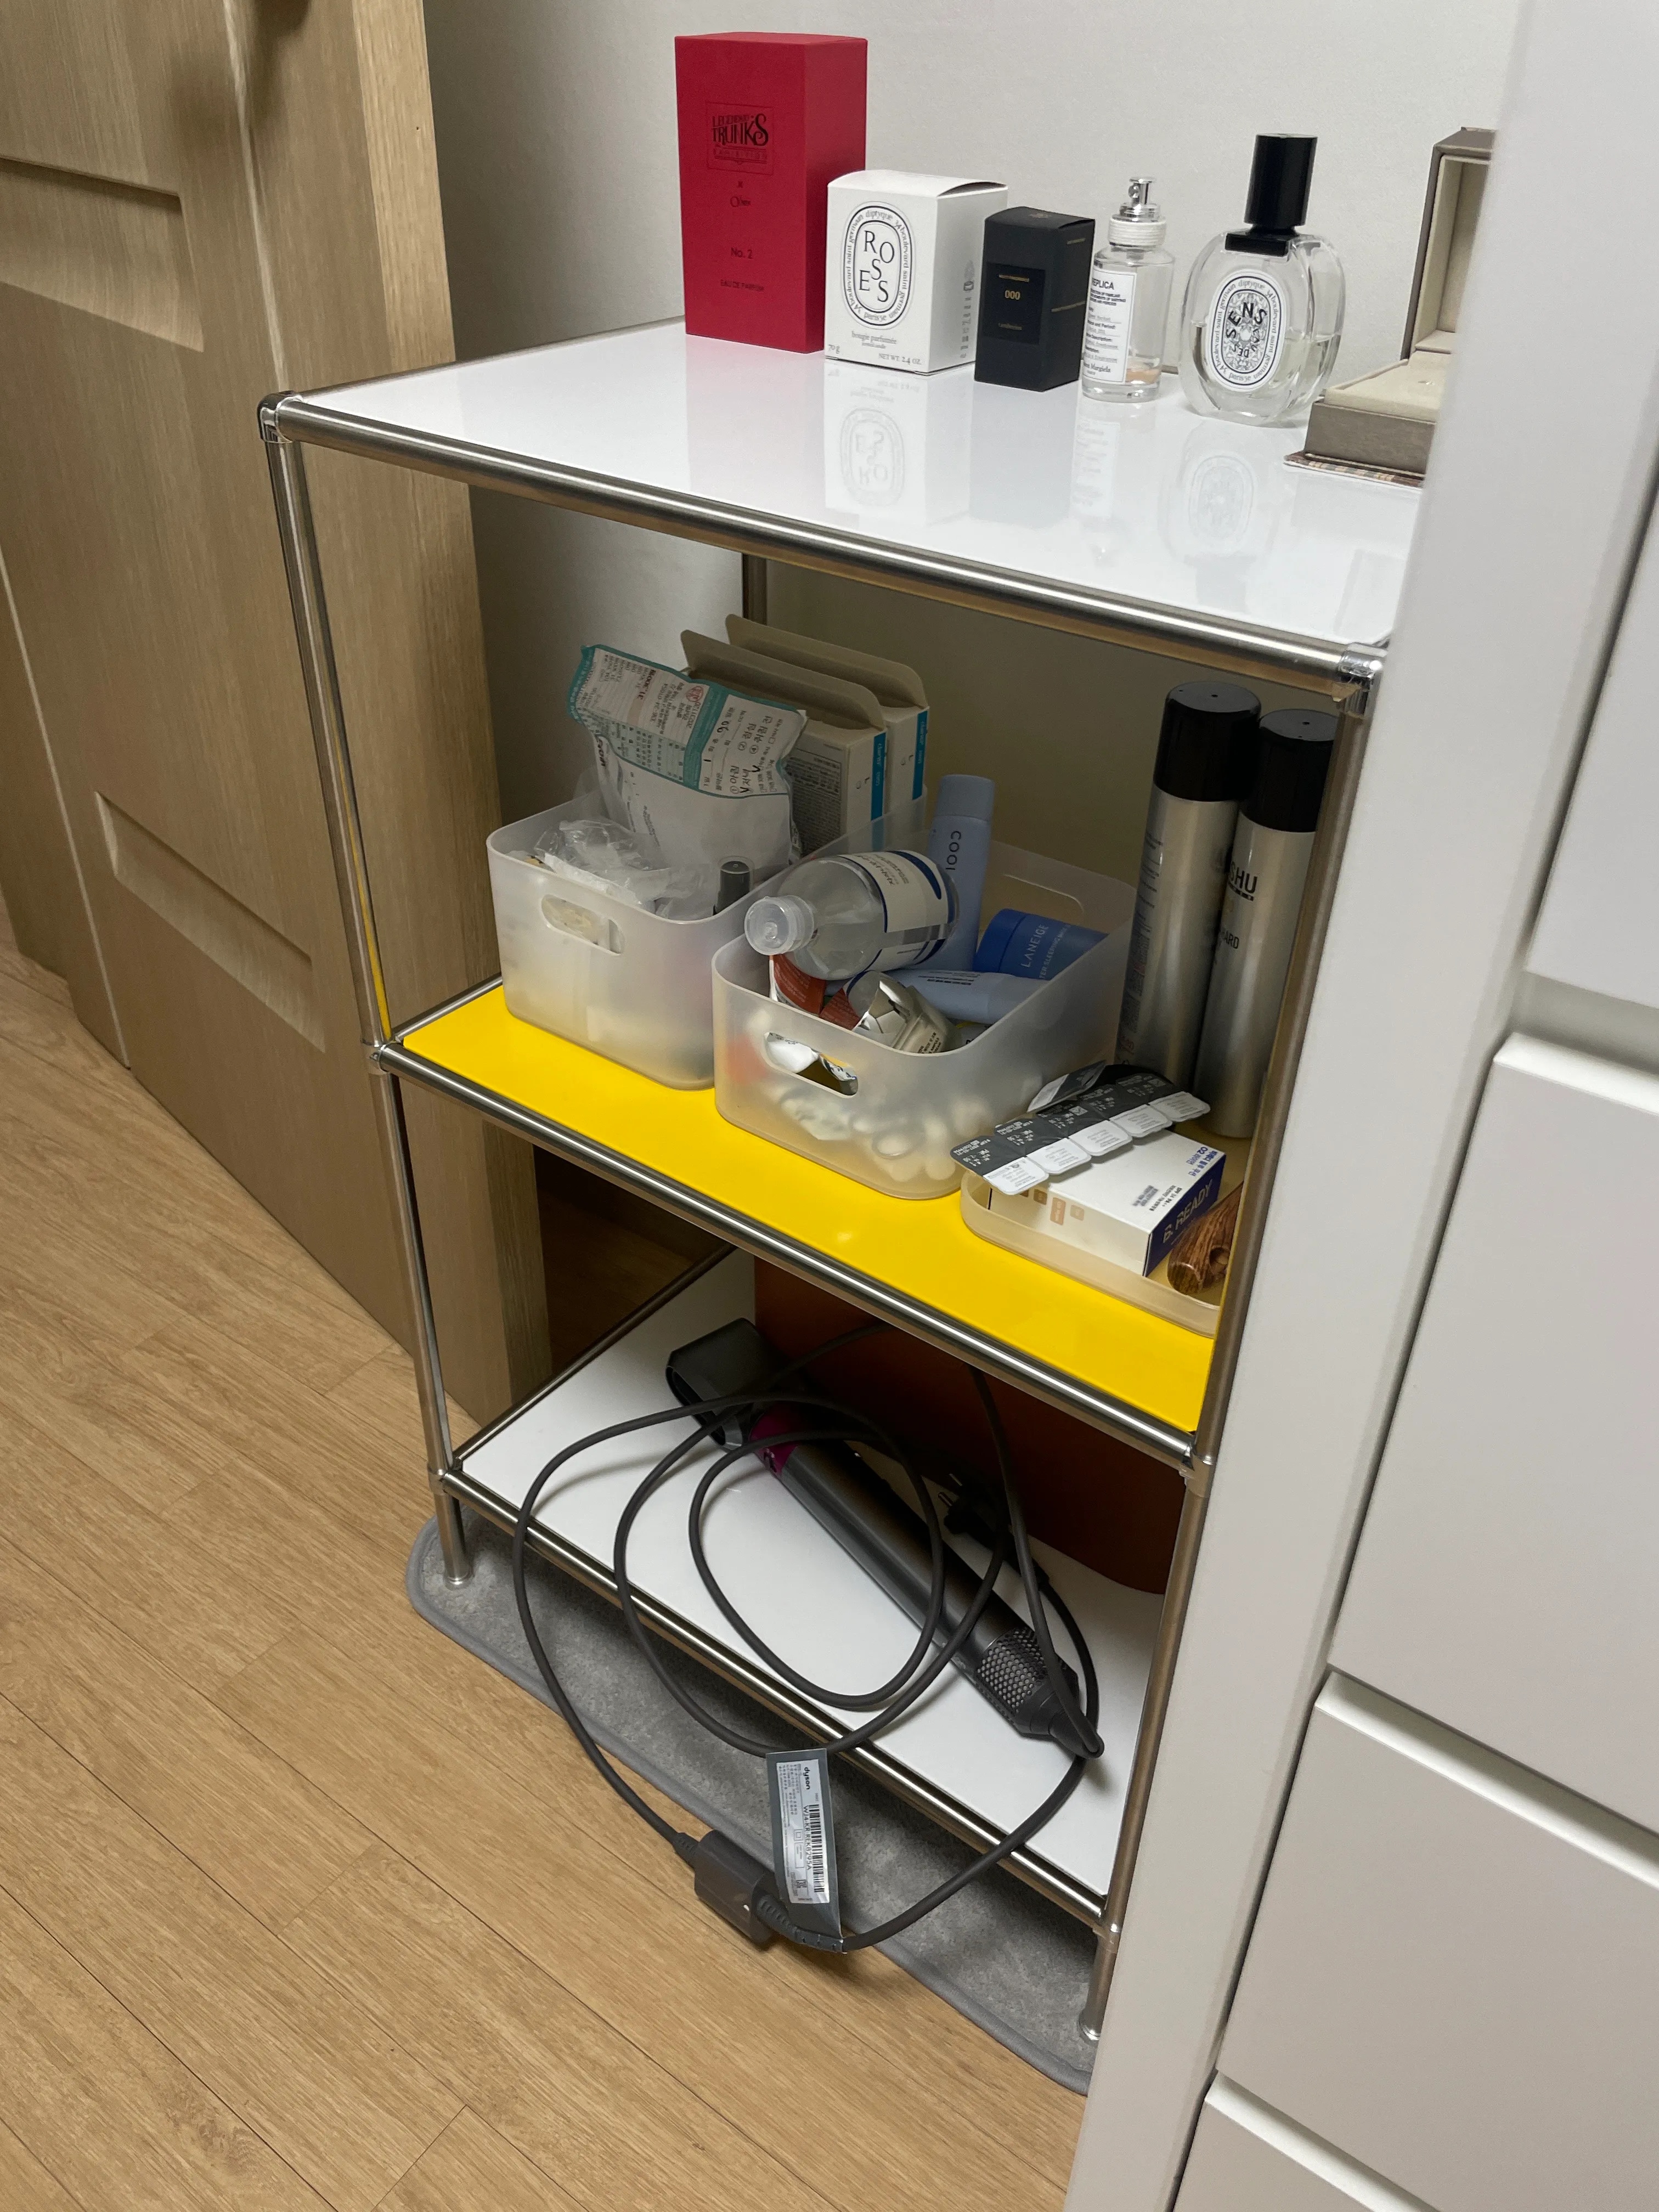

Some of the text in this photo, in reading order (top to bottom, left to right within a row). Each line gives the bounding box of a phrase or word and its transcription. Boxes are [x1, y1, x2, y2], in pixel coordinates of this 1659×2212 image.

[731, 246, 753, 259] No. 2
[901, 356, 911, 365] 2.4
[729, 765, 742, 784] 아침
[1020, 924, 1049, 969] LANEIGE
[1175, 1179, 1214, 1230] READY
